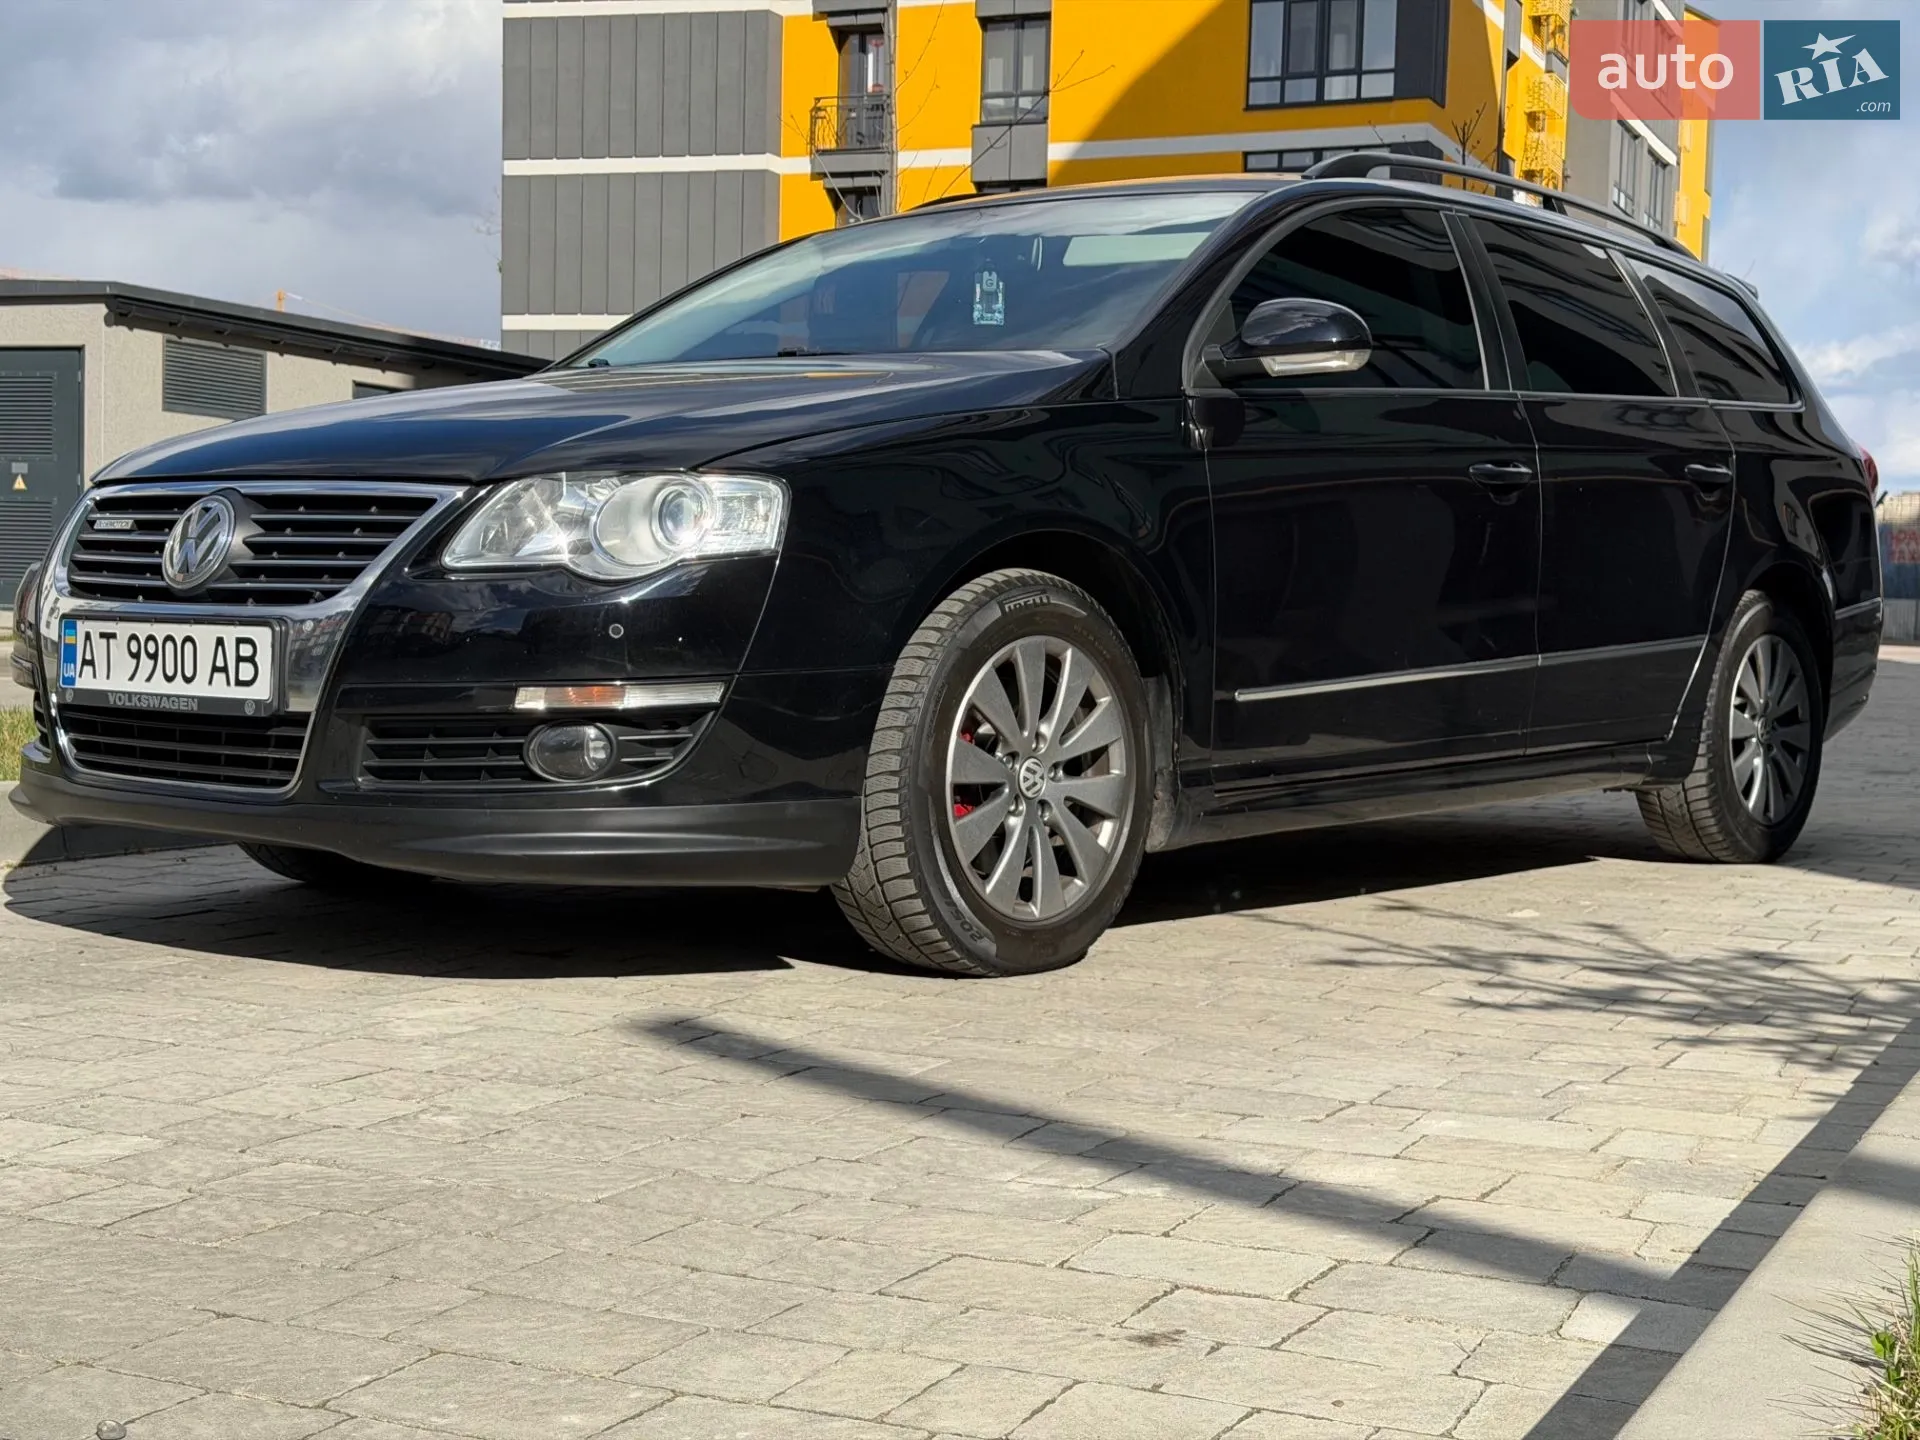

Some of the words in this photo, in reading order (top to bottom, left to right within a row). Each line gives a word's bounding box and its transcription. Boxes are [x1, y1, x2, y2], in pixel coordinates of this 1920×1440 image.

[996, 588, 1052, 617] PIRELLI
[63, 662, 75, 678] UA
[78, 631, 118, 681] AT
[126, 633, 198, 685] 9900
[208, 636, 260, 688] AB
[108, 691, 199, 712] VOLKSWAGEN
